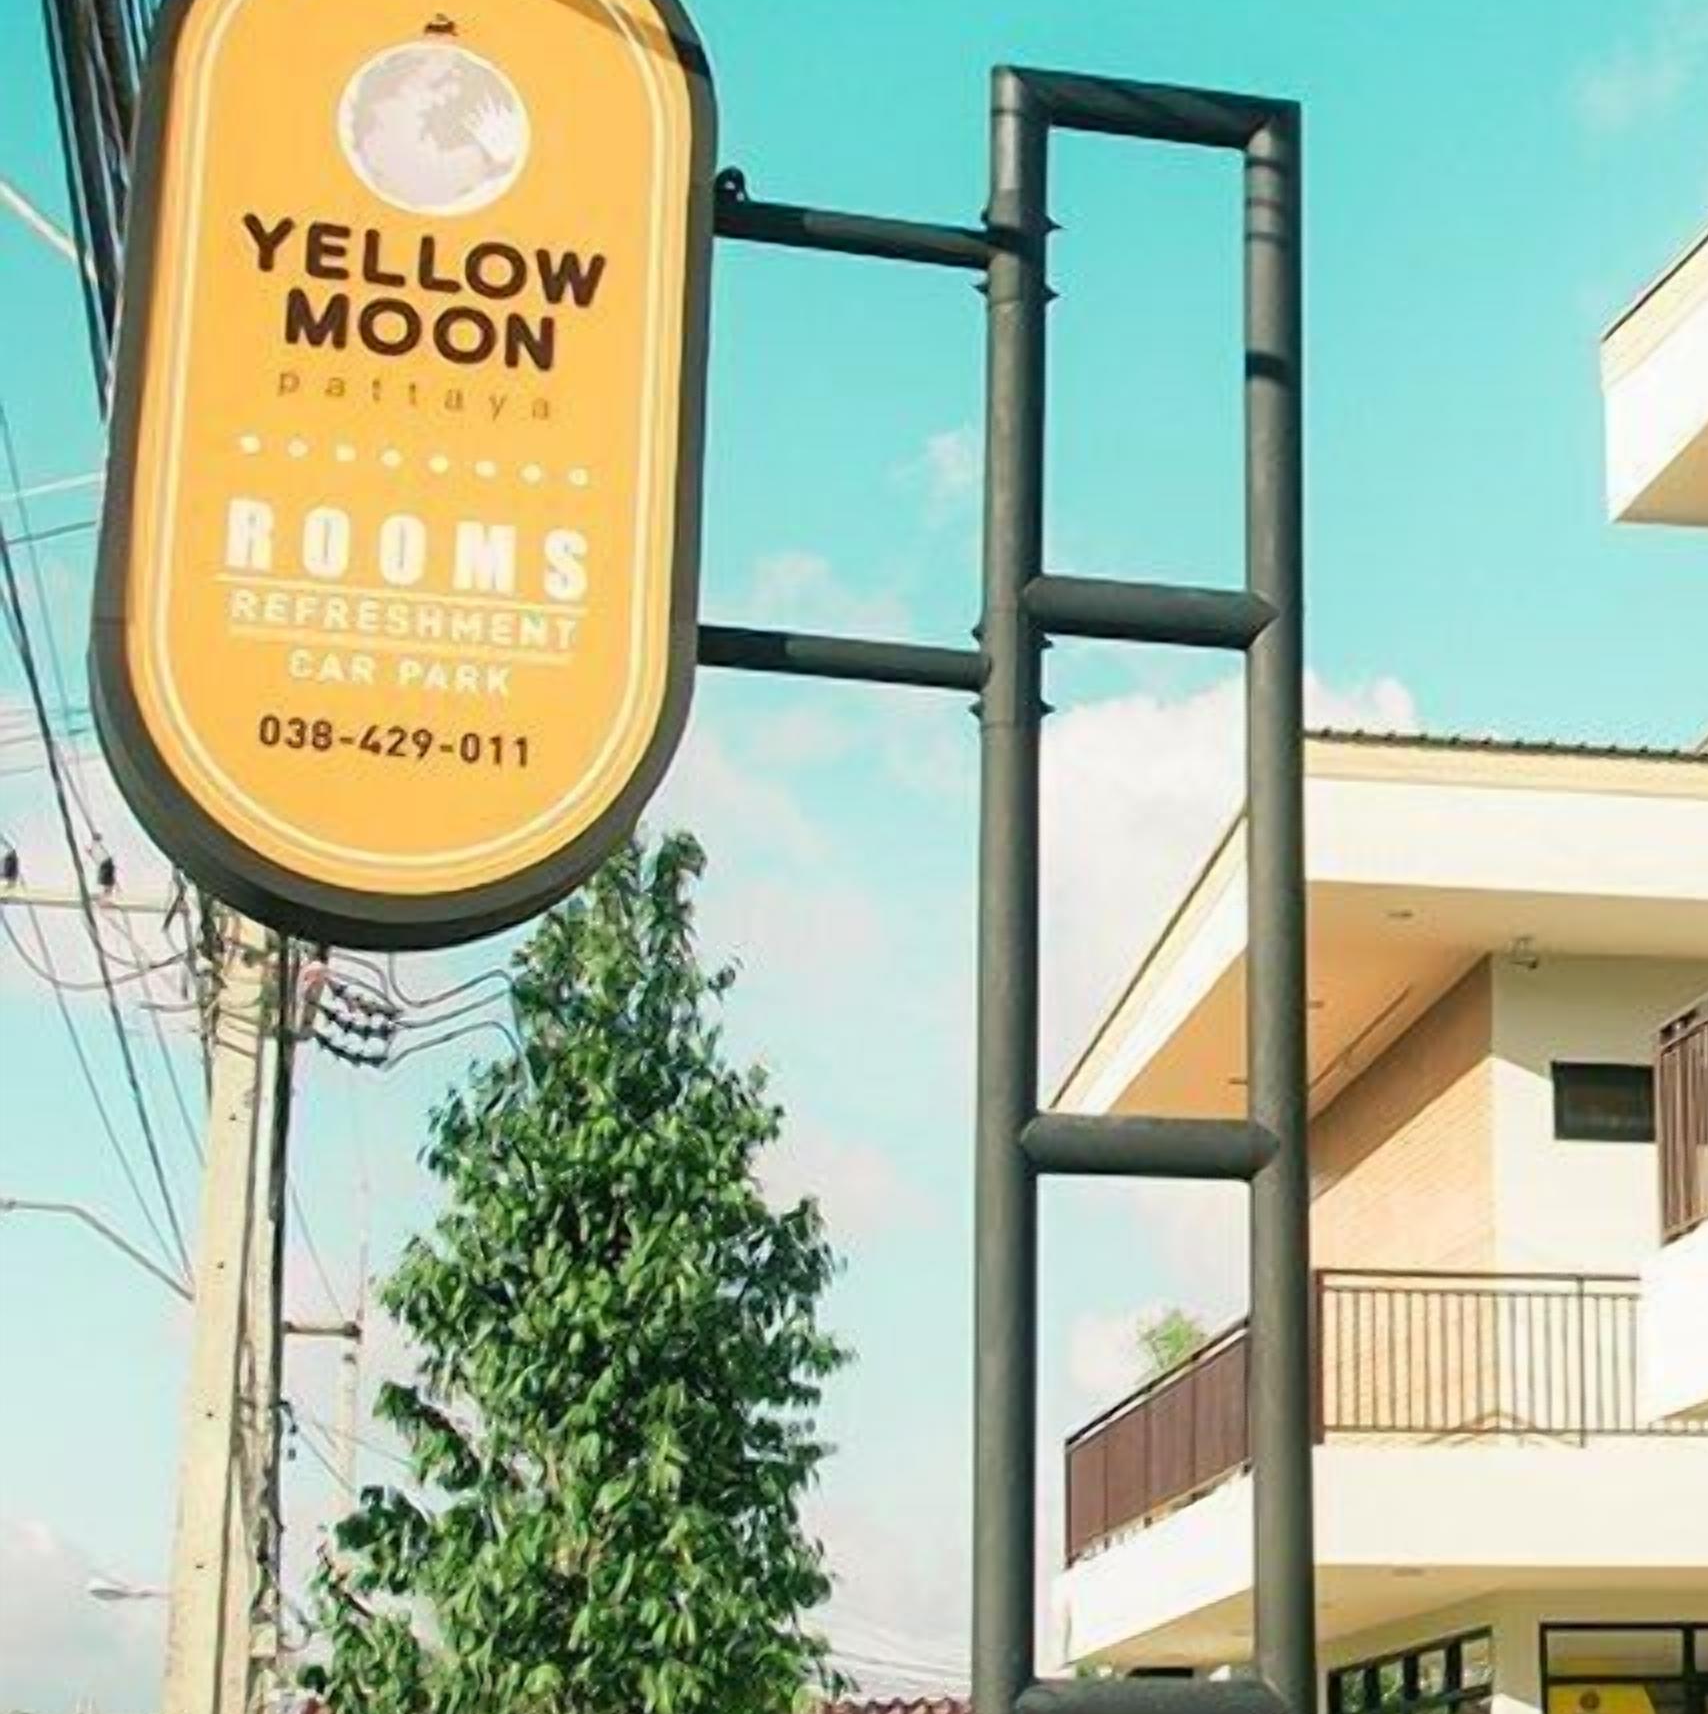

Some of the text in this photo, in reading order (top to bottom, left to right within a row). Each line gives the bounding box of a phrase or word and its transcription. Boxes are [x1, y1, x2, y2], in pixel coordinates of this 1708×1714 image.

[242, 213, 606, 307] YELLOW
[285, 288, 555, 371] MOON
[278, 372, 551, 420] pattaya
[225, 498, 589, 601] ROOMS
[230, 588, 577, 650] REFRESHMENT
[288, 648, 512, 696] CAR PARK
[258, 714, 530, 767] 038-429-011
